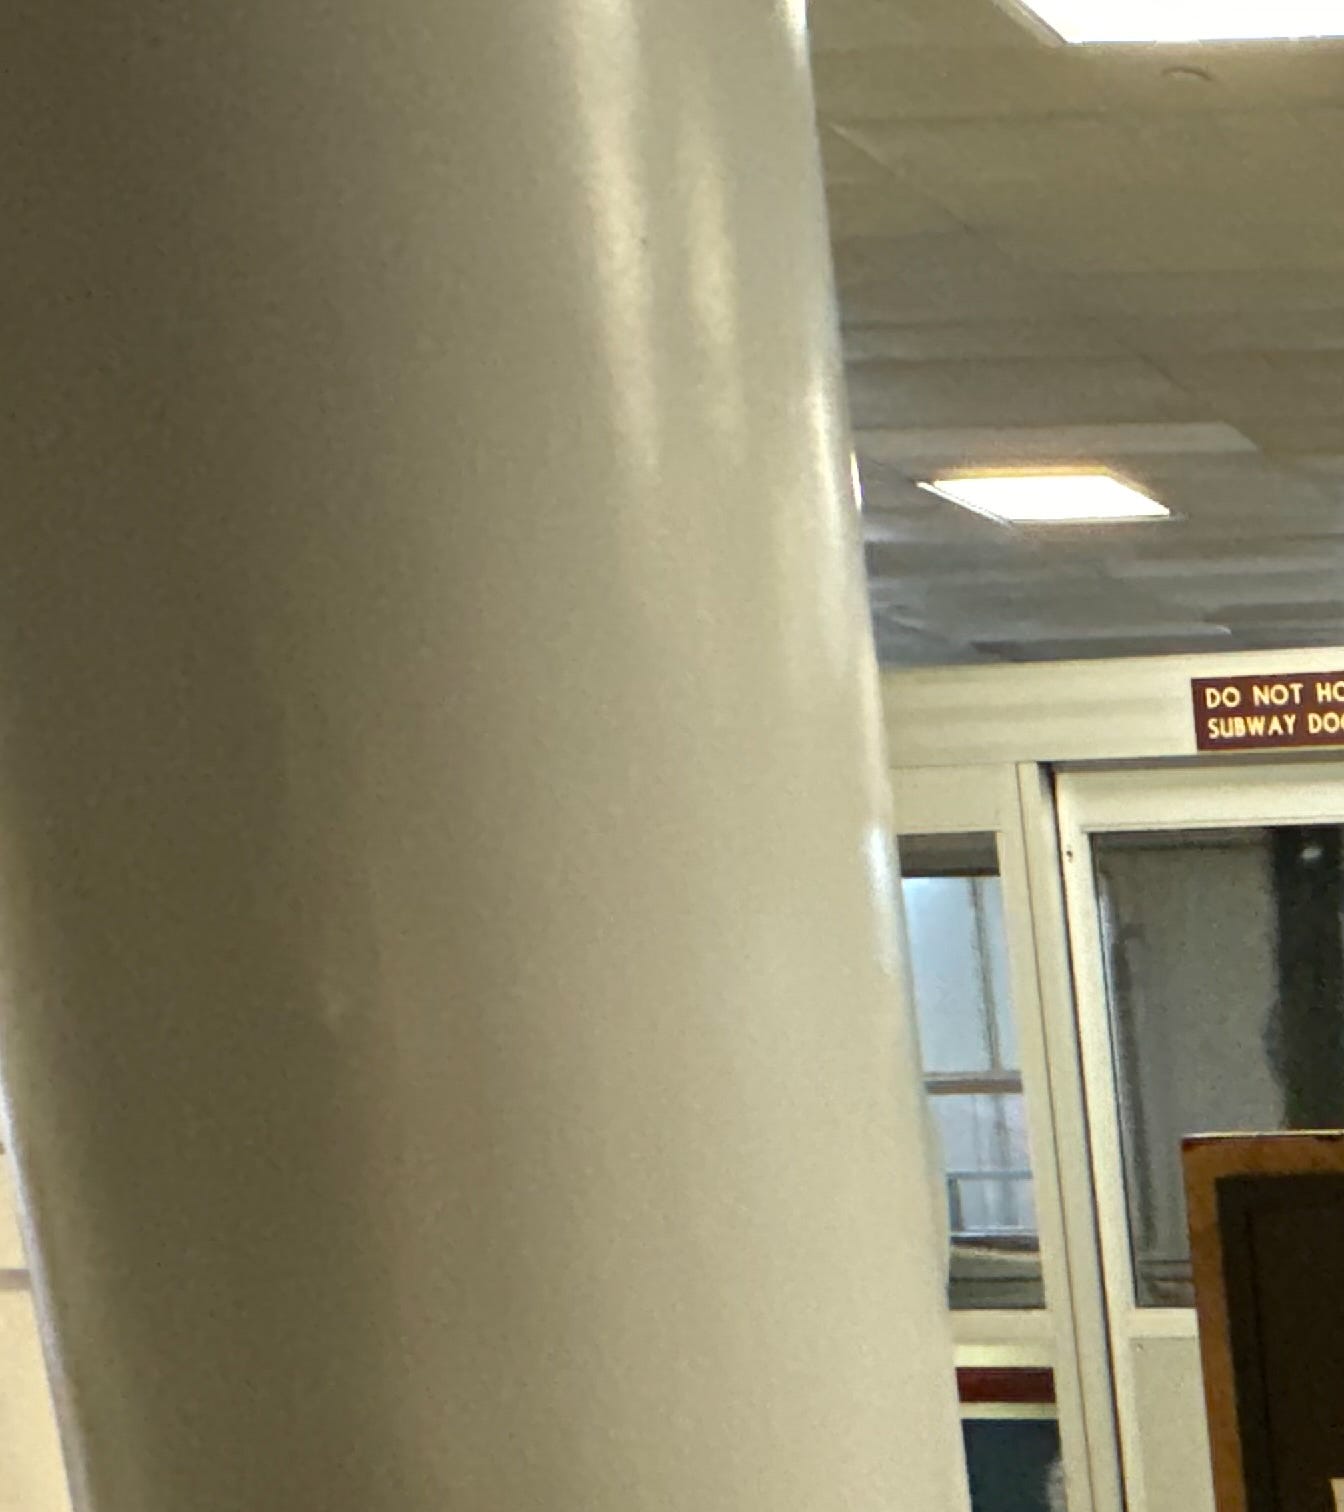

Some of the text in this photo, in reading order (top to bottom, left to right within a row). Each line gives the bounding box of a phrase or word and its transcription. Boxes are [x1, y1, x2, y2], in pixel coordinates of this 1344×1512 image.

[1205, 687, 1241, 709] DO
[1253, 683, 1304, 707] NOT
[1207, 714, 1296, 739] SUBWAY
